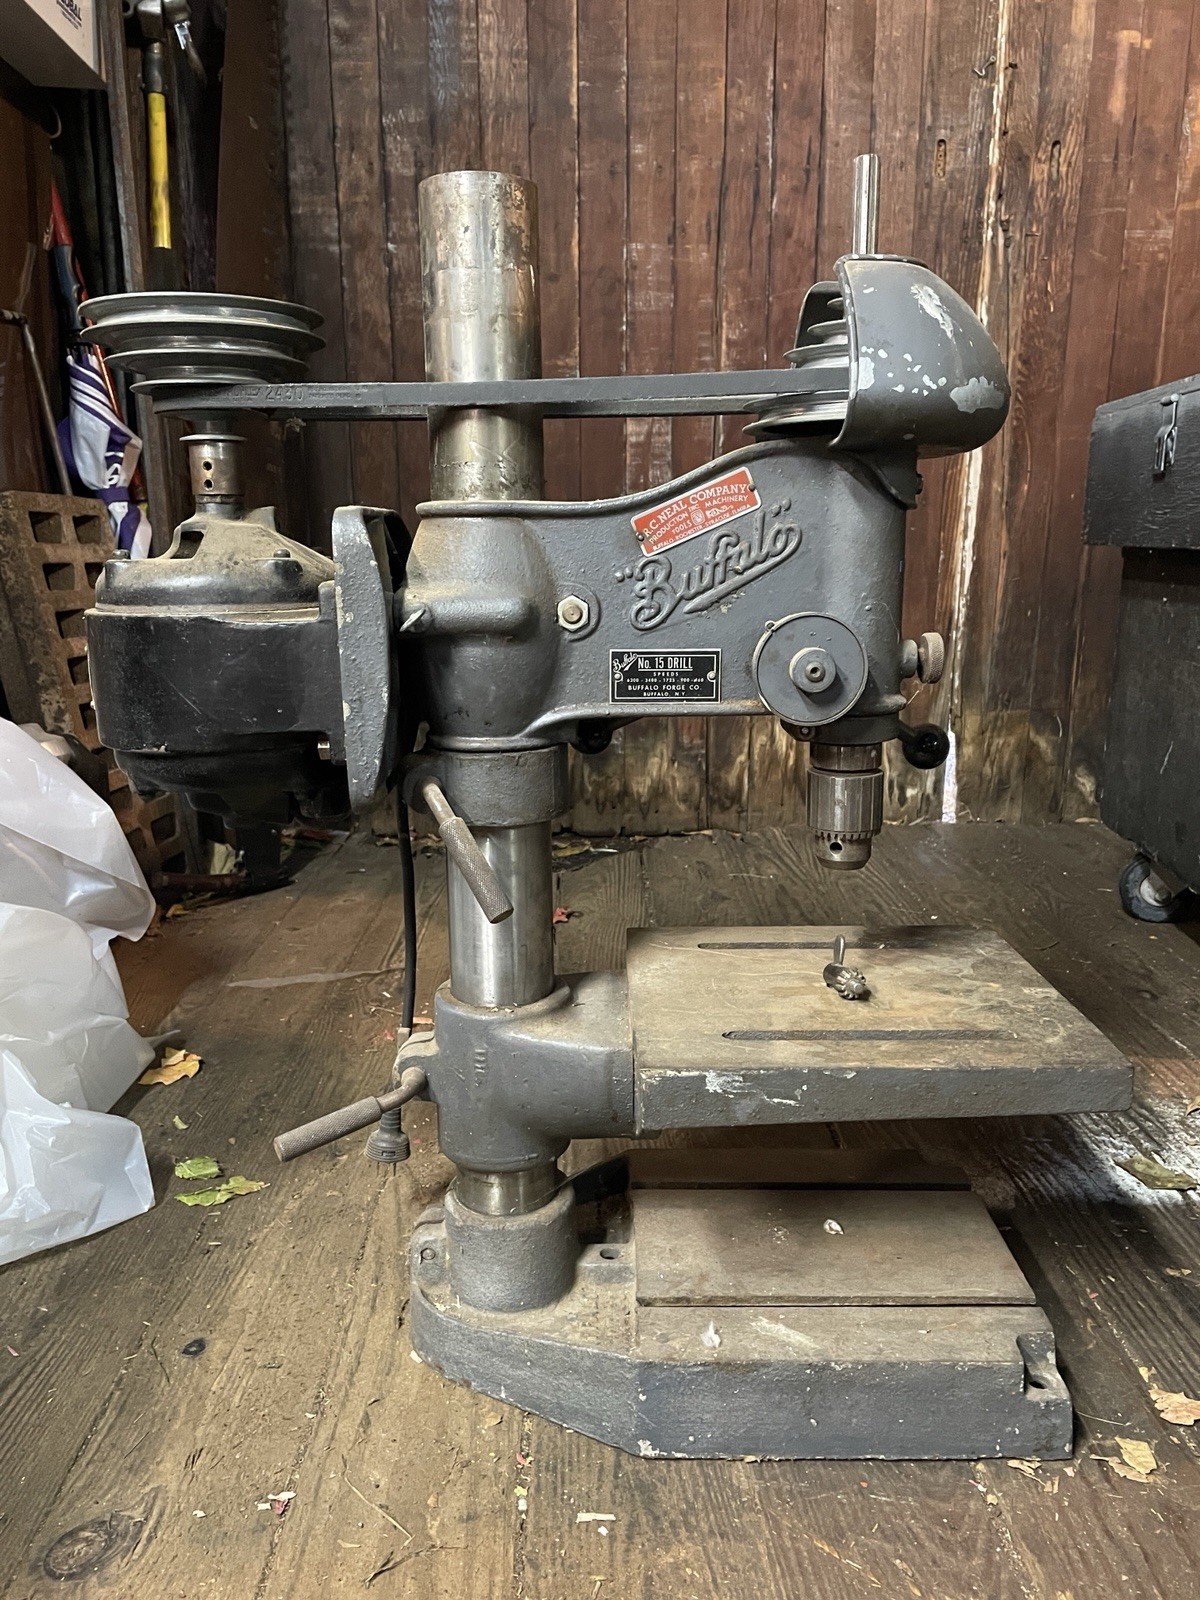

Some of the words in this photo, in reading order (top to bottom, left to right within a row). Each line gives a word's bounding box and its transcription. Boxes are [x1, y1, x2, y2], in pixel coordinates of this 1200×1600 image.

[688, 485, 747, 504] COMPANY
[648, 511, 689, 544] PRODUCTION
[704, 495, 748, 508] MACHINERY
[671, 519, 692, 534] TOOLS
[613, 652, 638, 672] Buffalo
[638, 657, 651, 669] No.
[655, 657, 664, 669] 15
[668, 657, 693, 669] DRILL
